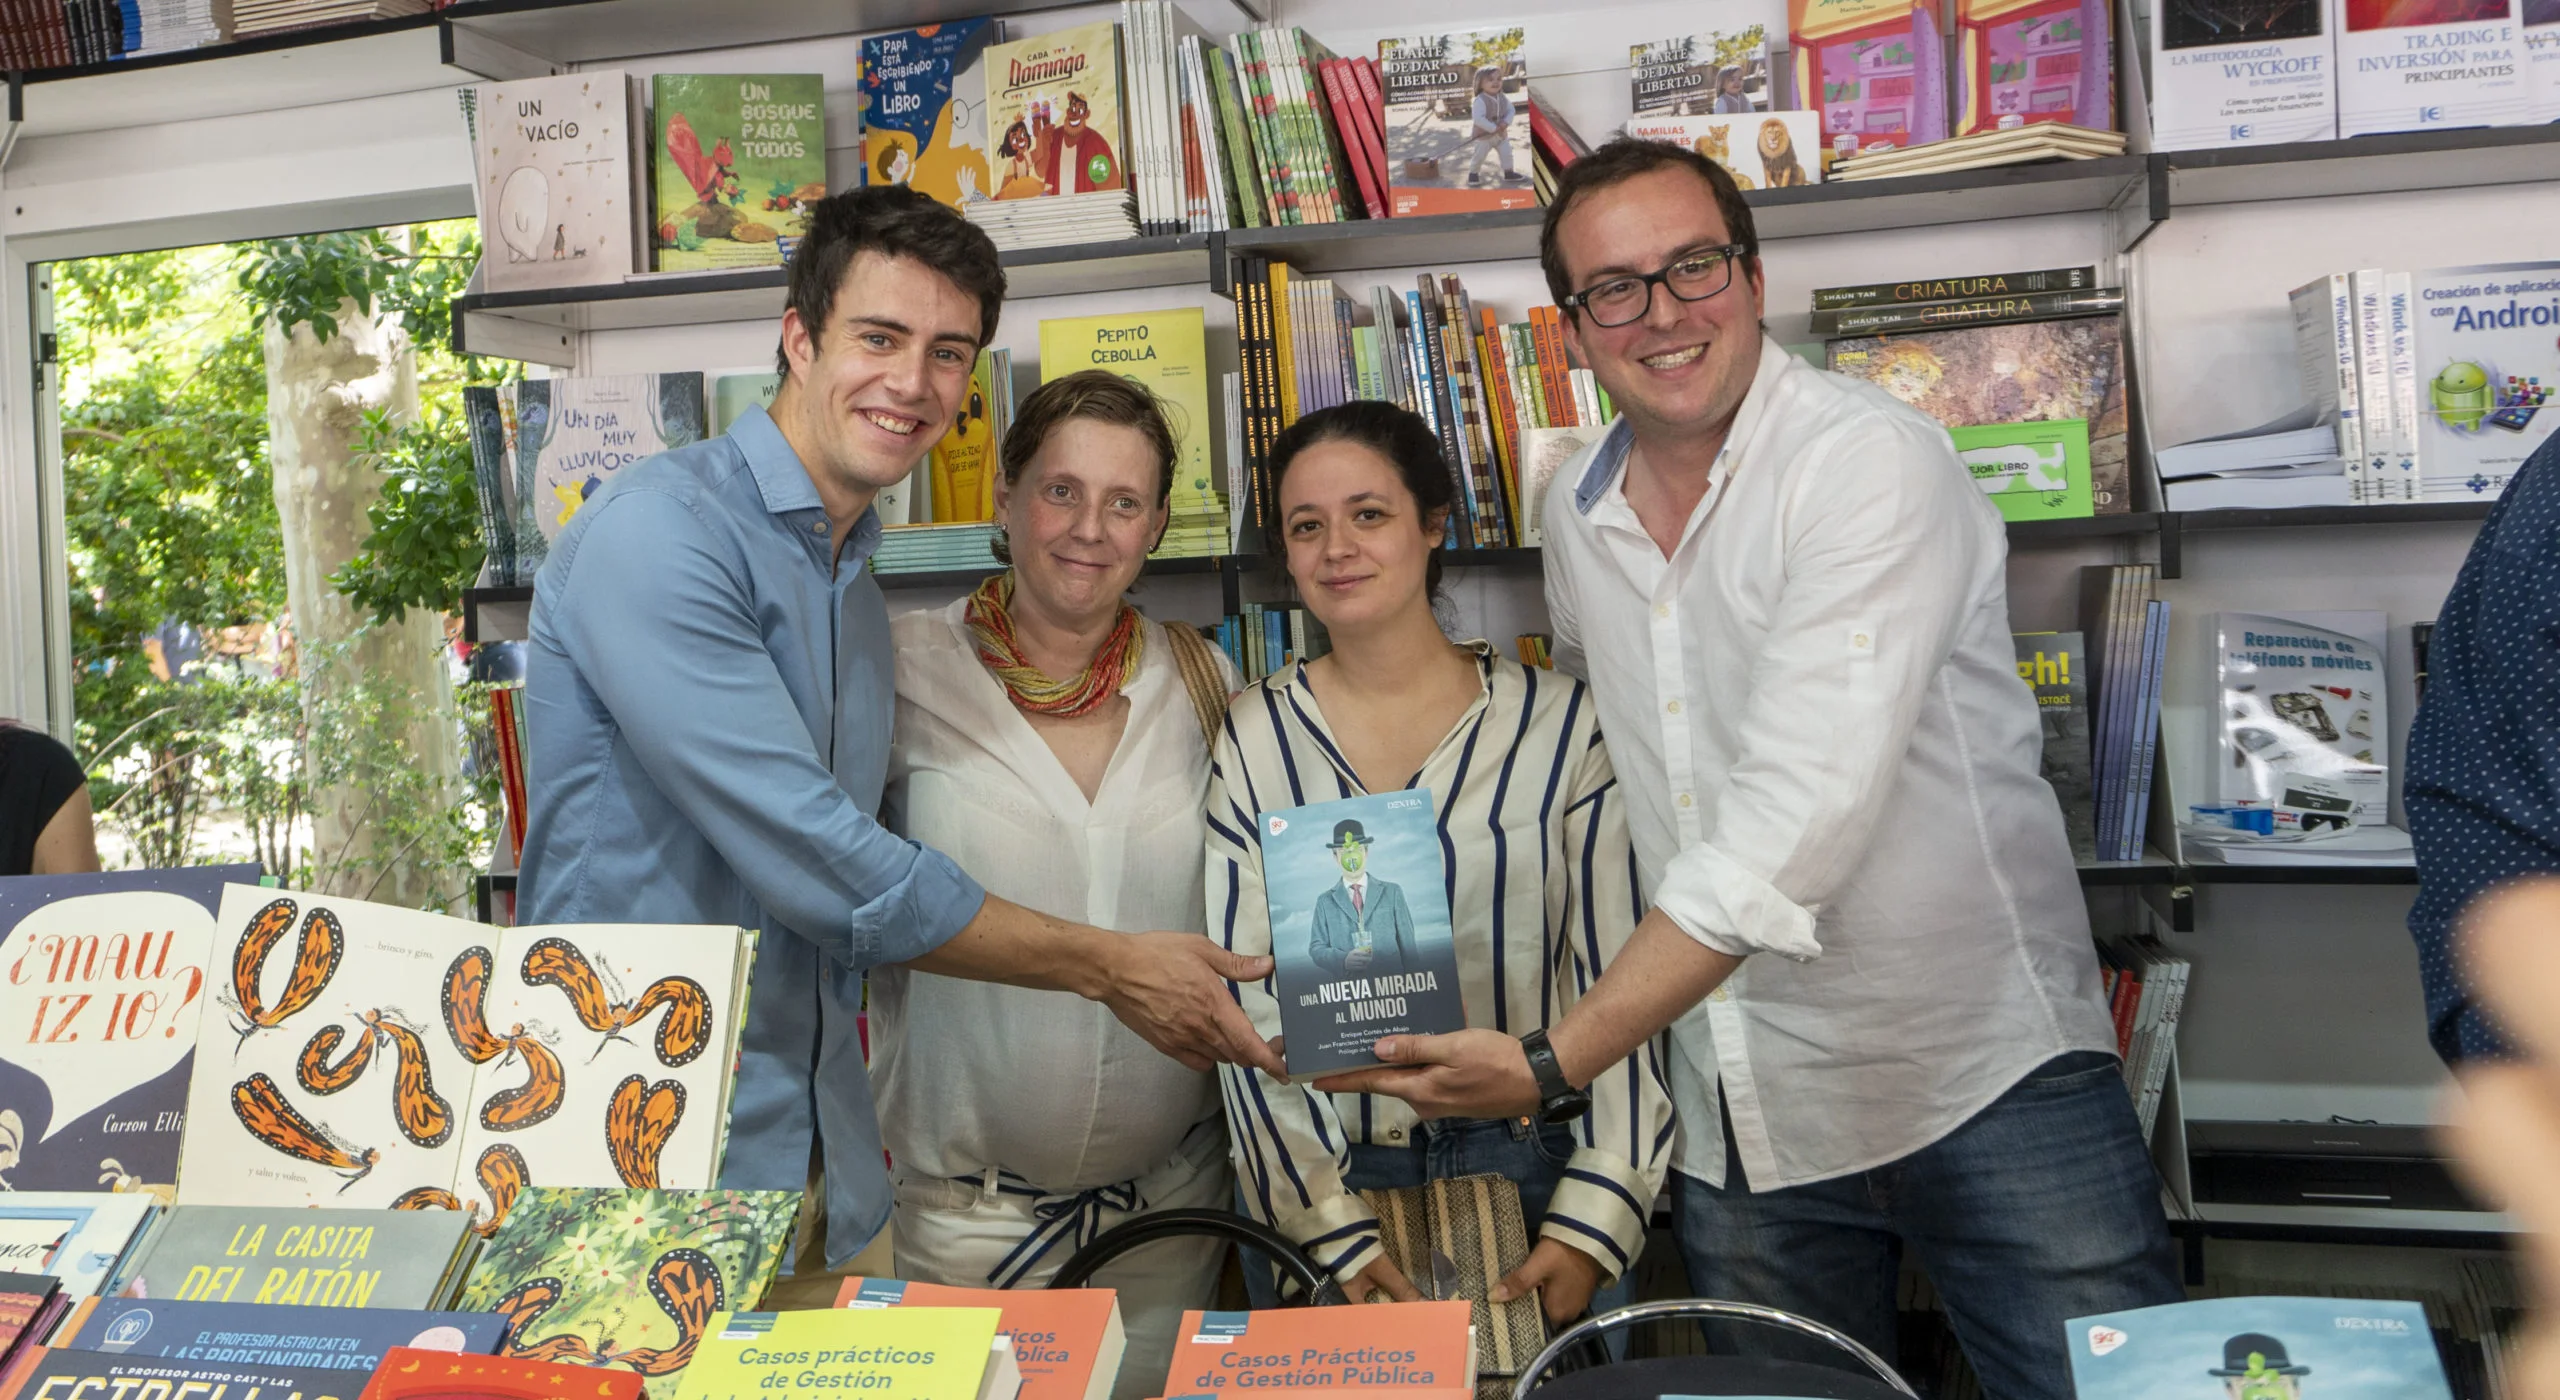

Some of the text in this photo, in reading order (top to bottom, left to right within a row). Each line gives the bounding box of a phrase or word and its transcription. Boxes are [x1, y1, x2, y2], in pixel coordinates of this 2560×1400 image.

[883, 36, 908, 54] PAPÁ
[2404, 29, 2495, 50] TRADING
[2501, 27, 2513, 42] E
[882, 54, 902, 66] ESTÁ
[1027, 50, 1049, 62] CADA
[1390, 46, 1443, 60] EL ARTE
[1640, 48, 1688, 66] EL ARTE
[2172, 46, 2284, 66] LA METODOLOGÍA
[2358, 48, 2466, 72] INVERSIÓN
[2473, 49, 2513, 62] PARA
[877, 60, 932, 80] ESCRIBIENDO
[1391, 60, 1441, 74] DE DAR
[1640, 63, 1686, 80] DE DAR
[2223, 55, 2324, 78] WYCKOFF
[2404, 64, 2514, 84] PRINCIPIANTES
[893, 80, 907, 93] UN
[1391, 72, 1458, 87] LIBERTAD
[1640, 74, 1702, 94] LIBERTAD
[740, 82, 770, 102] UN
[517, 99, 542, 118] UN
[742, 103, 817, 121] BOSQUE
[882, 93, 921, 115] LIBRO
[525, 120, 580, 143] VACÍO
[742, 122, 800, 140] PARA
[1637, 126, 1685, 136] FAMILIAS
[742, 141, 806, 158] TODOS
[1823, 277, 2009, 302] SHAUN TAN CRIATURA
[2422, 283, 2501, 300] Creación de
[1848, 299, 2034, 326] SHAUN TAN CRIATURA
[2431, 306, 2455, 318] con
[1097, 324, 1149, 343] PEPITO
[1091, 345, 1157, 364] CEBOLLA
[1424, 311, 1446, 396] EMIGRANTES
[1442, 424, 1456, 461] SHAUN
[564, 408, 619, 431] UN DÍA
[602, 430, 636, 448] MUY
[558, 450, 648, 472] LLUVIOS
[1967, 462, 2029, 475] EJOR LIBRO
[2244, 631, 2354, 653] Reparación de
[2311, 654, 2374, 672] móviles
[1387, 798, 1423, 810] DEXTRA
[377, 940, 406, 954] brinco
[407, 949, 413, 957] y
[1300, 970, 1438, 1007] UNA NUEVA MIRADA
[26, 994, 93, 1044] IZ
[1335, 996, 1408, 1025] AL MUNDO
[1332, 1039, 1359, 1048] Francisco
[1340, 1031, 1362, 1039] Enrique
[103, 1111, 183, 1134] Carson Elli
[248, 1169, 254, 1177] y
[255, 1168, 273, 1179] salto
[275, 1172, 281, 1181] y
[225, 1224, 375, 1259] LA CASITA
[253, 1260, 382, 1309] RATÓN
[196, 1331, 361, 1352] EL PROFESOR ASTRO CAT EN
[739, 1345, 935, 1369] Casos prácticos
[1015, 1346, 1070, 1363] blica
[1220, 1345, 1416, 1369] Casos Prácticos
[110, 1366, 294, 1388] EL PROFESOR ASTRO CAT Y LAS
[760, 1370, 892, 1389] de Gestión
[1195, 1365, 1435, 1388] de Gestión Pública
